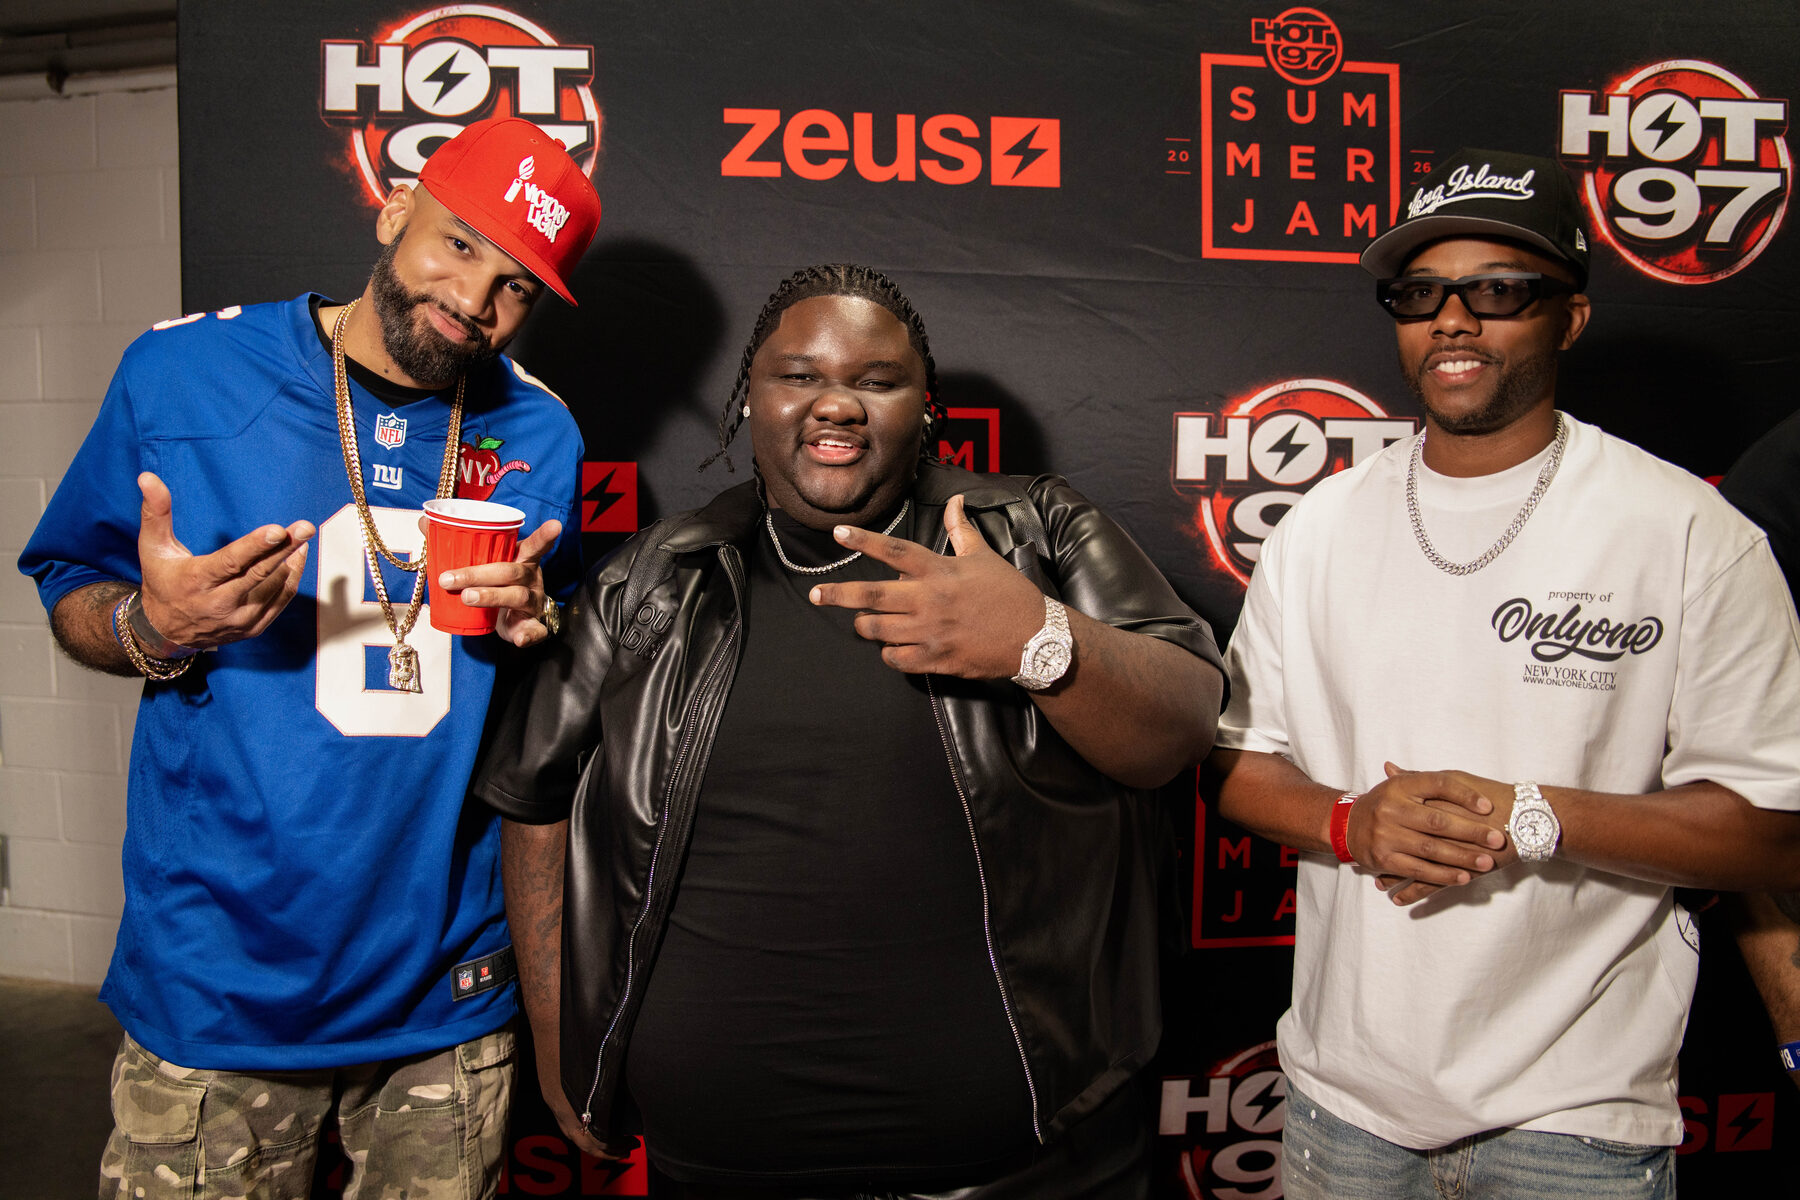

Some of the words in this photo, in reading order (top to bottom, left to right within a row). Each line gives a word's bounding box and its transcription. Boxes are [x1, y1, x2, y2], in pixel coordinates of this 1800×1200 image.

[1250, 17, 1335, 46] HOT
[1277, 44, 1336, 71] 97
[324, 41, 589, 117] HOT
[1560, 92, 1786, 163] HOT
[720, 107, 983, 186] zeus
[1167, 149, 1190, 163] 20
[1412, 160, 1432, 174] 26
[1446, 163, 1536, 197] Island
[524, 182, 571, 229] VICTORY
[1613, 166, 1783, 244] 97
[379, 426, 402, 444] NFL
[1174, 412, 1416, 487] HOT
[456, 456, 492, 487] NY
[1548, 591, 1596, 604] property
[1600, 592, 1614, 602] of
[1491, 597, 1664, 663] Onlyone
[1524, 664, 1552, 678] NEW
[1554, 667, 1587, 681] YORK
[1590, 671, 1618, 684] CITY
[1217, 835, 1298, 870] ME
[1220, 888, 1297, 923] JA
[1158, 1070, 1287, 1136] HO
[1210, 1139, 1287, 1200] 9
